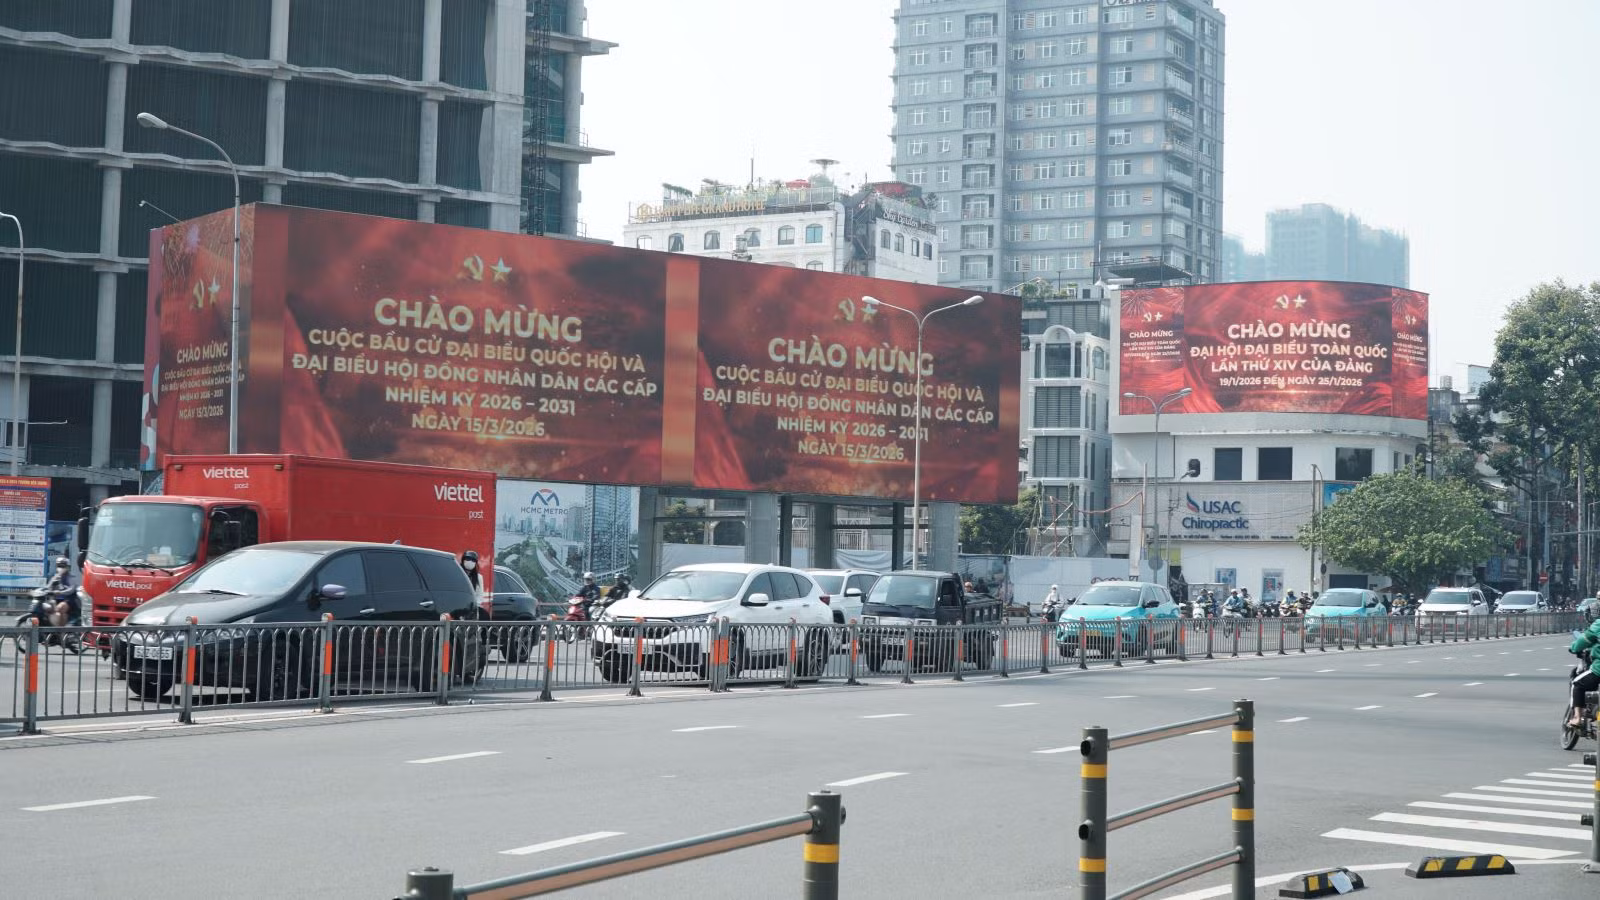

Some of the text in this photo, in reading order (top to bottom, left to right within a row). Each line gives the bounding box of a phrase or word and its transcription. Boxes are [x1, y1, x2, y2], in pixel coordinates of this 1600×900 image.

[737, 200, 765, 211] HOTEL
[374, 295, 582, 343] CHÀO MỪNG
[1228, 319, 1351, 339] CHÀO MỪNG
[1129, 329, 1174, 338] CHÀO MỪNG
[177, 341, 228, 363] CHÀO MỪNG
[309, 327, 645, 373] CUỘC BẦU CỬ ĐẠI BIỂU QUỐC HỘI VÀ
[768, 335, 934, 376] CHÀO MỪNG
[1190, 346, 1213, 360] ĐẠI
[1217, 342, 1241, 359] HỘI
[1244, 344, 1268, 358] ĐẠI
[1273, 340, 1307, 355] BIỂU
[1311, 342, 1350, 356] TOÀN
[1354, 344, 1388, 359] QUỐC
[292, 352, 657, 397] ĐẠI BIỂU HỘI ĐỒNG NHÂN DÂN CÁC CẤP
[1211, 356, 1373, 373] LẦN THỨ XIV CỦA ĐẢNG
[716, 364, 984, 403] CUỘC BẦU CỬ ĐẠI BIỂU QUỐC HỘI VÀ
[1220, 375, 1362, 387] 19/1/2026 ĐẾN NGÀY 25/1/2026
[385, 385, 446, 408] NHIỆM
[452, 389, 476, 407] KỲ
[480, 393, 522, 411] 2026
[538, 398, 576, 416] 2031
[703, 386, 994, 424] ĐẠI BIỂU HỘI ĐỒNG NHÂN DÂN CÁC CẤP
[411, 412, 544, 436] NGÀY 15/3/2026
[777, 416, 825, 436] NHIỆM
[830, 418, 848, 435] KỲ
[852, 422, 886, 437] 2026
[798, 438, 904, 460] NGÀY 15/3/2026
[203, 466, 249, 479] viettel
[234, 482, 249, 490] post
[434, 481, 484, 503] viettel
[468, 509, 484, 520] post
[520, 506, 569, 515] HCMC METRO
[1202, 501, 1241, 514] USAC
[1182, 517, 1249, 531] Chiropractic
[113, 596, 144, 605] ISUU
